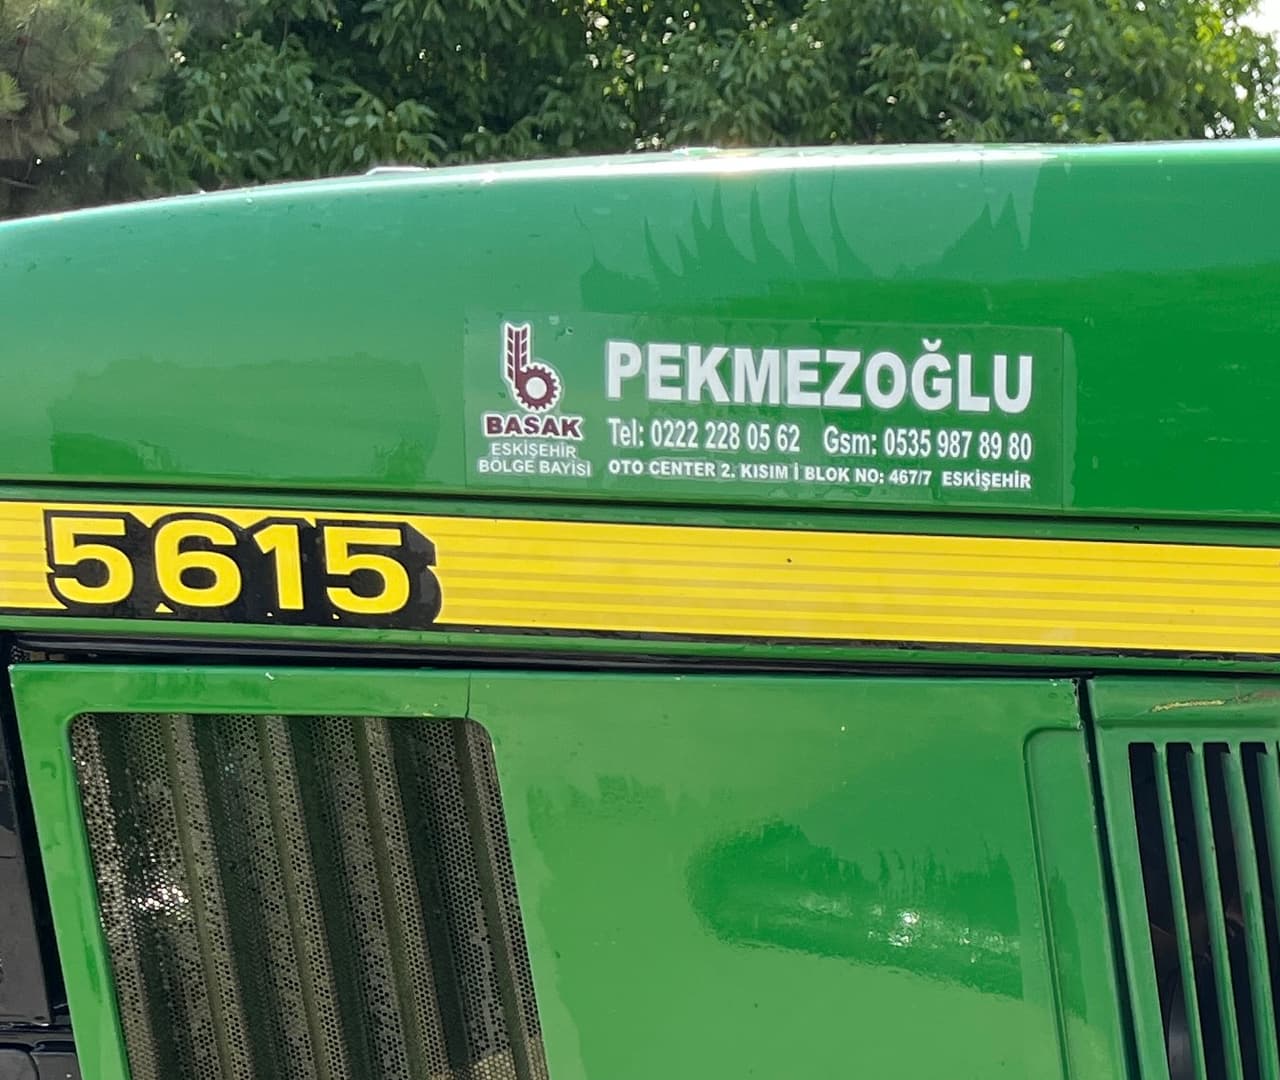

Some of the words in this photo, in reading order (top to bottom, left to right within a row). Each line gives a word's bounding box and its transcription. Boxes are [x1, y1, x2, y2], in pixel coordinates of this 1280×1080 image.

[606, 338, 1033, 413] PEKMEZOĞLU
[485, 415, 582, 438] BASAK
[607, 417, 645, 448] Tel:
[650, 419, 699, 449] 0222
[704, 421, 741, 450] 228
[746, 422, 771, 451] 05
[775, 423, 801, 452] 62
[823, 424, 878, 455] Gsm:
[883, 427, 932, 457] 0535
[937, 429, 973, 459] 987
[978, 431, 1002, 460] 89
[1007, 432, 1033, 461] 80
[491, 439, 577, 459] ESKİŞEHİR
[478, 457, 535, 474] BÖLGE
[538, 459, 592, 477] BAYİSİ
[607, 459, 644, 475] OTO
[649, 460, 716, 478] CENTER
[720, 462, 736, 478] 2.
[740, 463, 789, 480] KISIM
[804, 466, 851, 482] BLOK
[855, 468, 885, 484] NO:
[888, 469, 933, 486] 467/7
[941, 468, 1032, 491] ESKİŞEHİR
[47, 513, 418, 619] 5615
